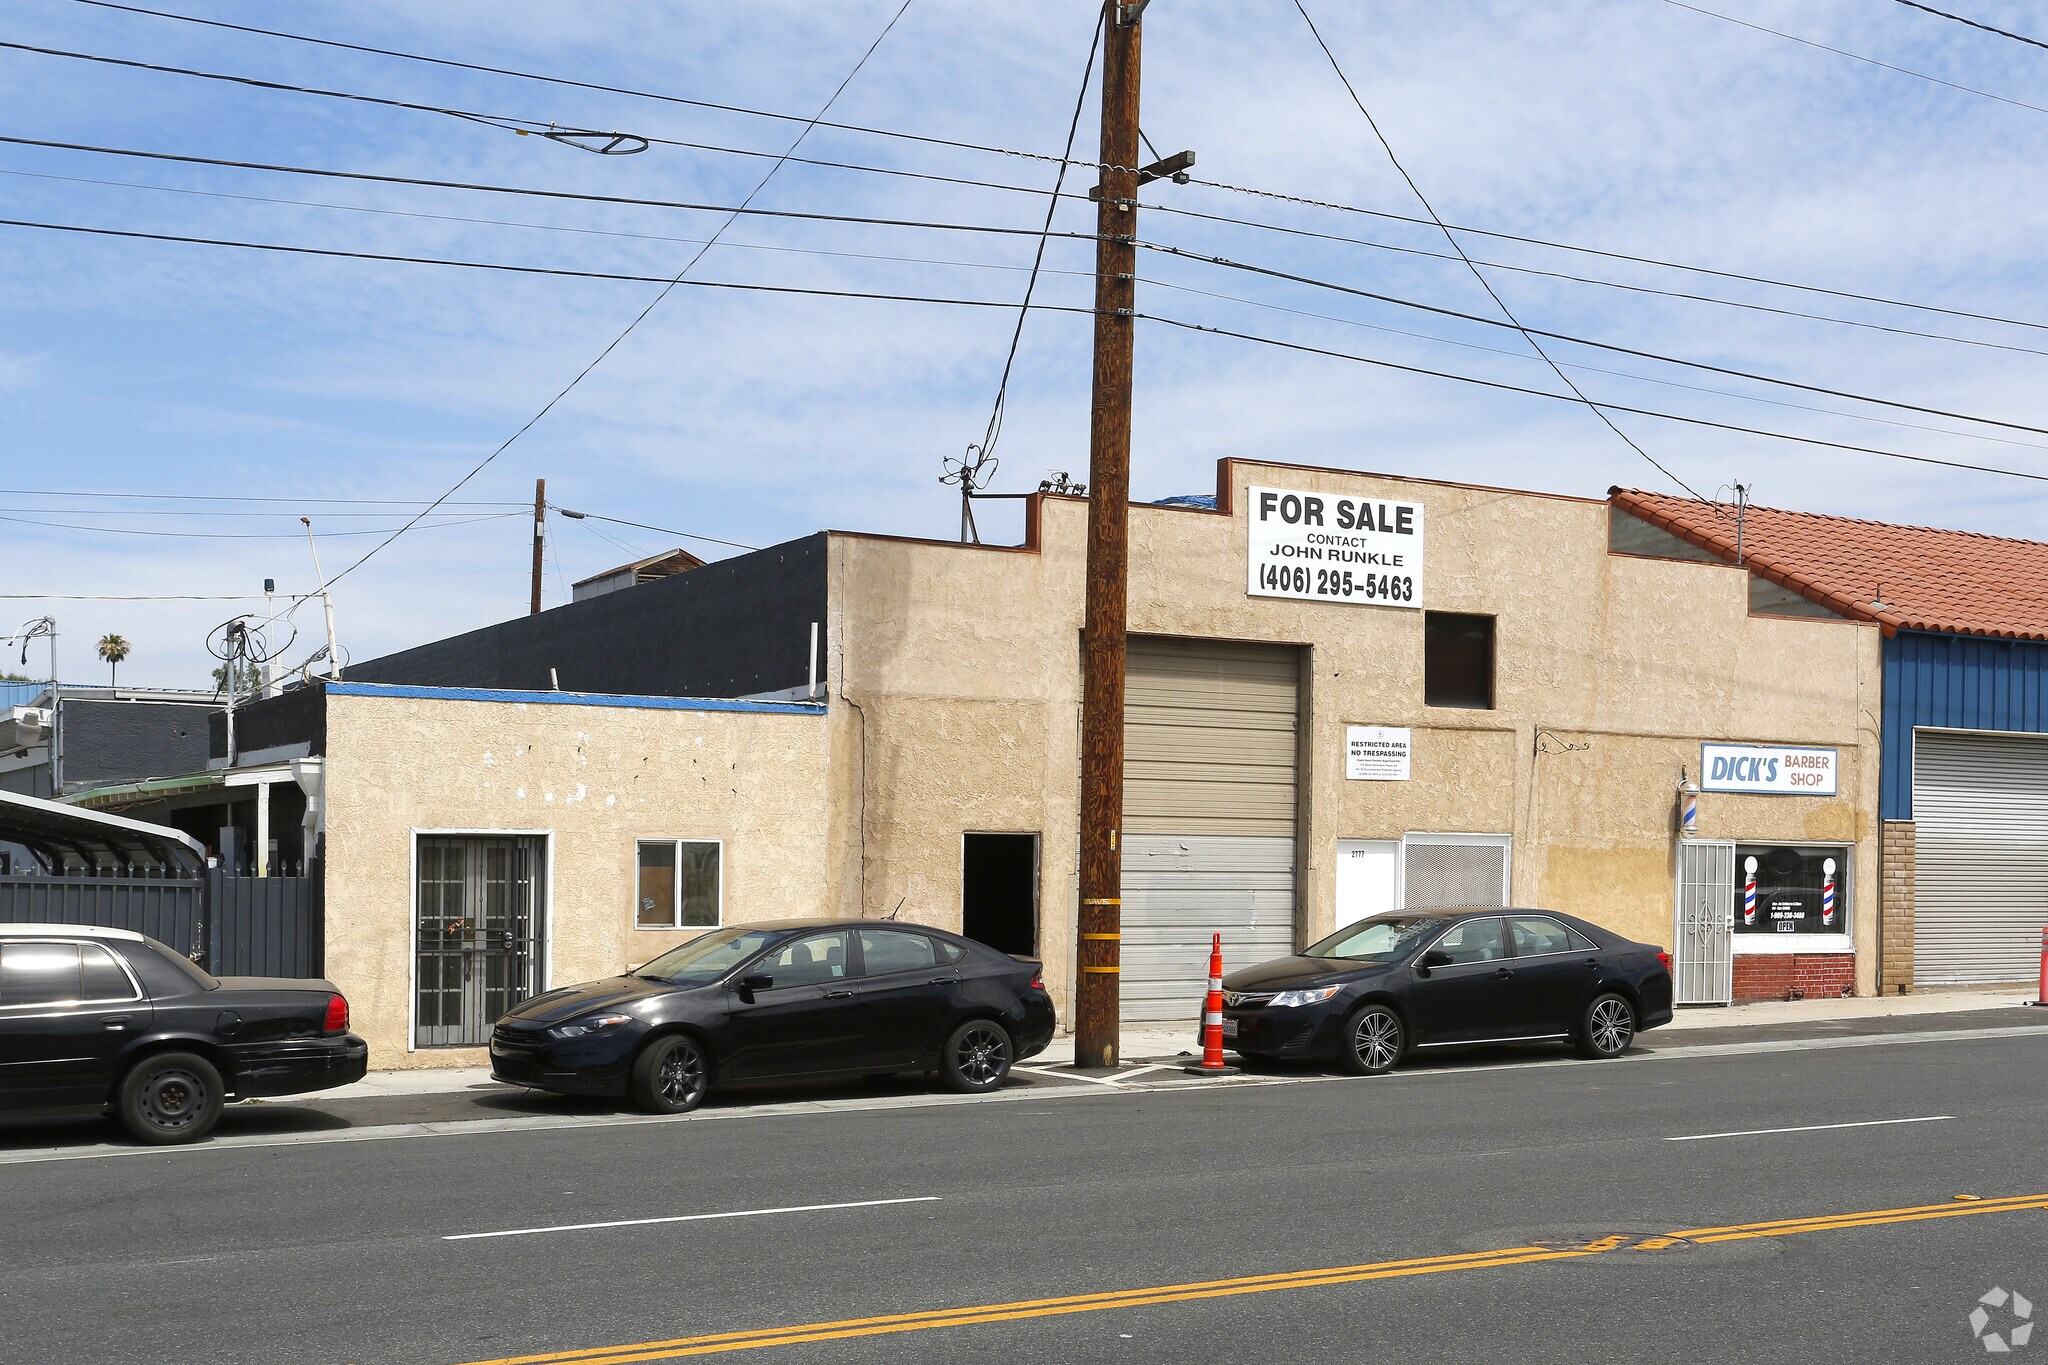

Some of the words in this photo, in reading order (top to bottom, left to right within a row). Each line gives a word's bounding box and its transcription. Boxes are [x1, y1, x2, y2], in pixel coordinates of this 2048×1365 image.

[1260, 492, 1324, 527] FOR
[1336, 499, 1414, 535] SALE
[1306, 533, 1367, 548] CONTACT
[1270, 544, 1322, 560] JOHN
[1328, 549, 1404, 567] RUNKLE
[1259, 563, 1311, 593] (406)
[1317, 568, 1413, 601] 295-5463
[1710, 756, 1779, 782] DICK'S
[1784, 755, 1829, 769] BARBER
[1790, 773, 1823, 786] SHOP
[1351, 850, 1365, 858] 2777
[1779, 922, 1793, 930] OPEN
